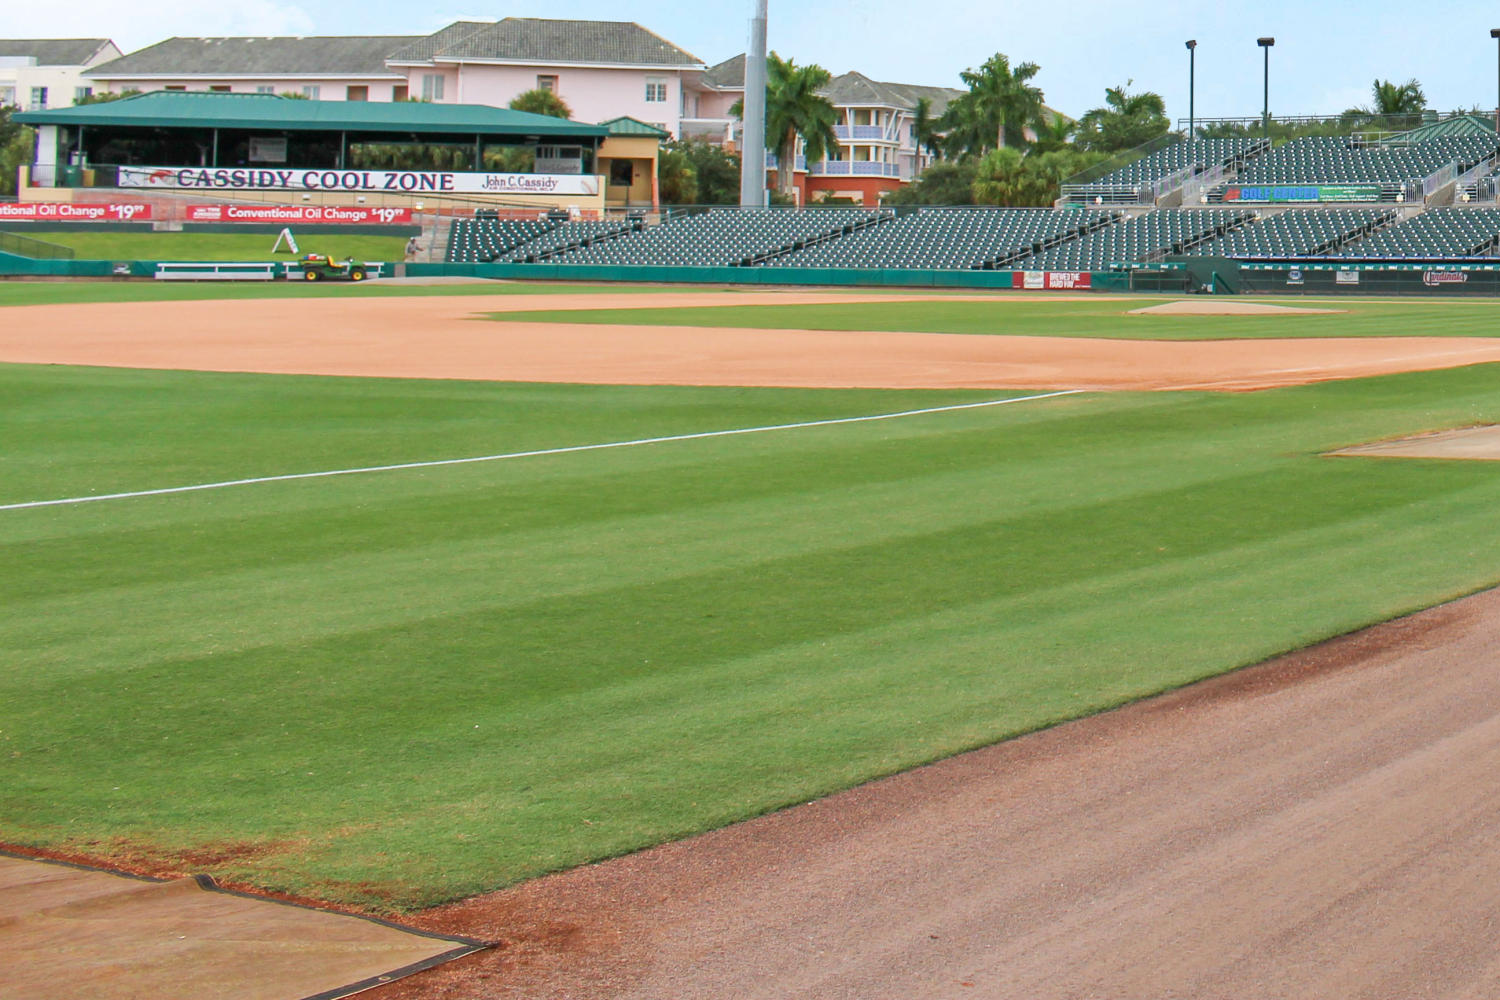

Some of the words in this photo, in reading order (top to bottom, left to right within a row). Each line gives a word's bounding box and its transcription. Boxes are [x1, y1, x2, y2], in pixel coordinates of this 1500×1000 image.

[177, 169, 293, 188] CASSIDY
[302, 171, 375, 190] COOL
[384, 173, 454, 190] ZONE
[482, 175, 506, 189] John
[518, 175, 559, 191] Cassidy
[1241, 187, 1271, 200] GOLF
[1273, 187, 1318, 200] CENTER
[39, 205, 56, 216] Oil
[58, 206, 105, 219] Change
[227, 206, 303, 219] Conventional
[304, 207, 322, 219] Oil
[323, 208, 368, 222] Change
